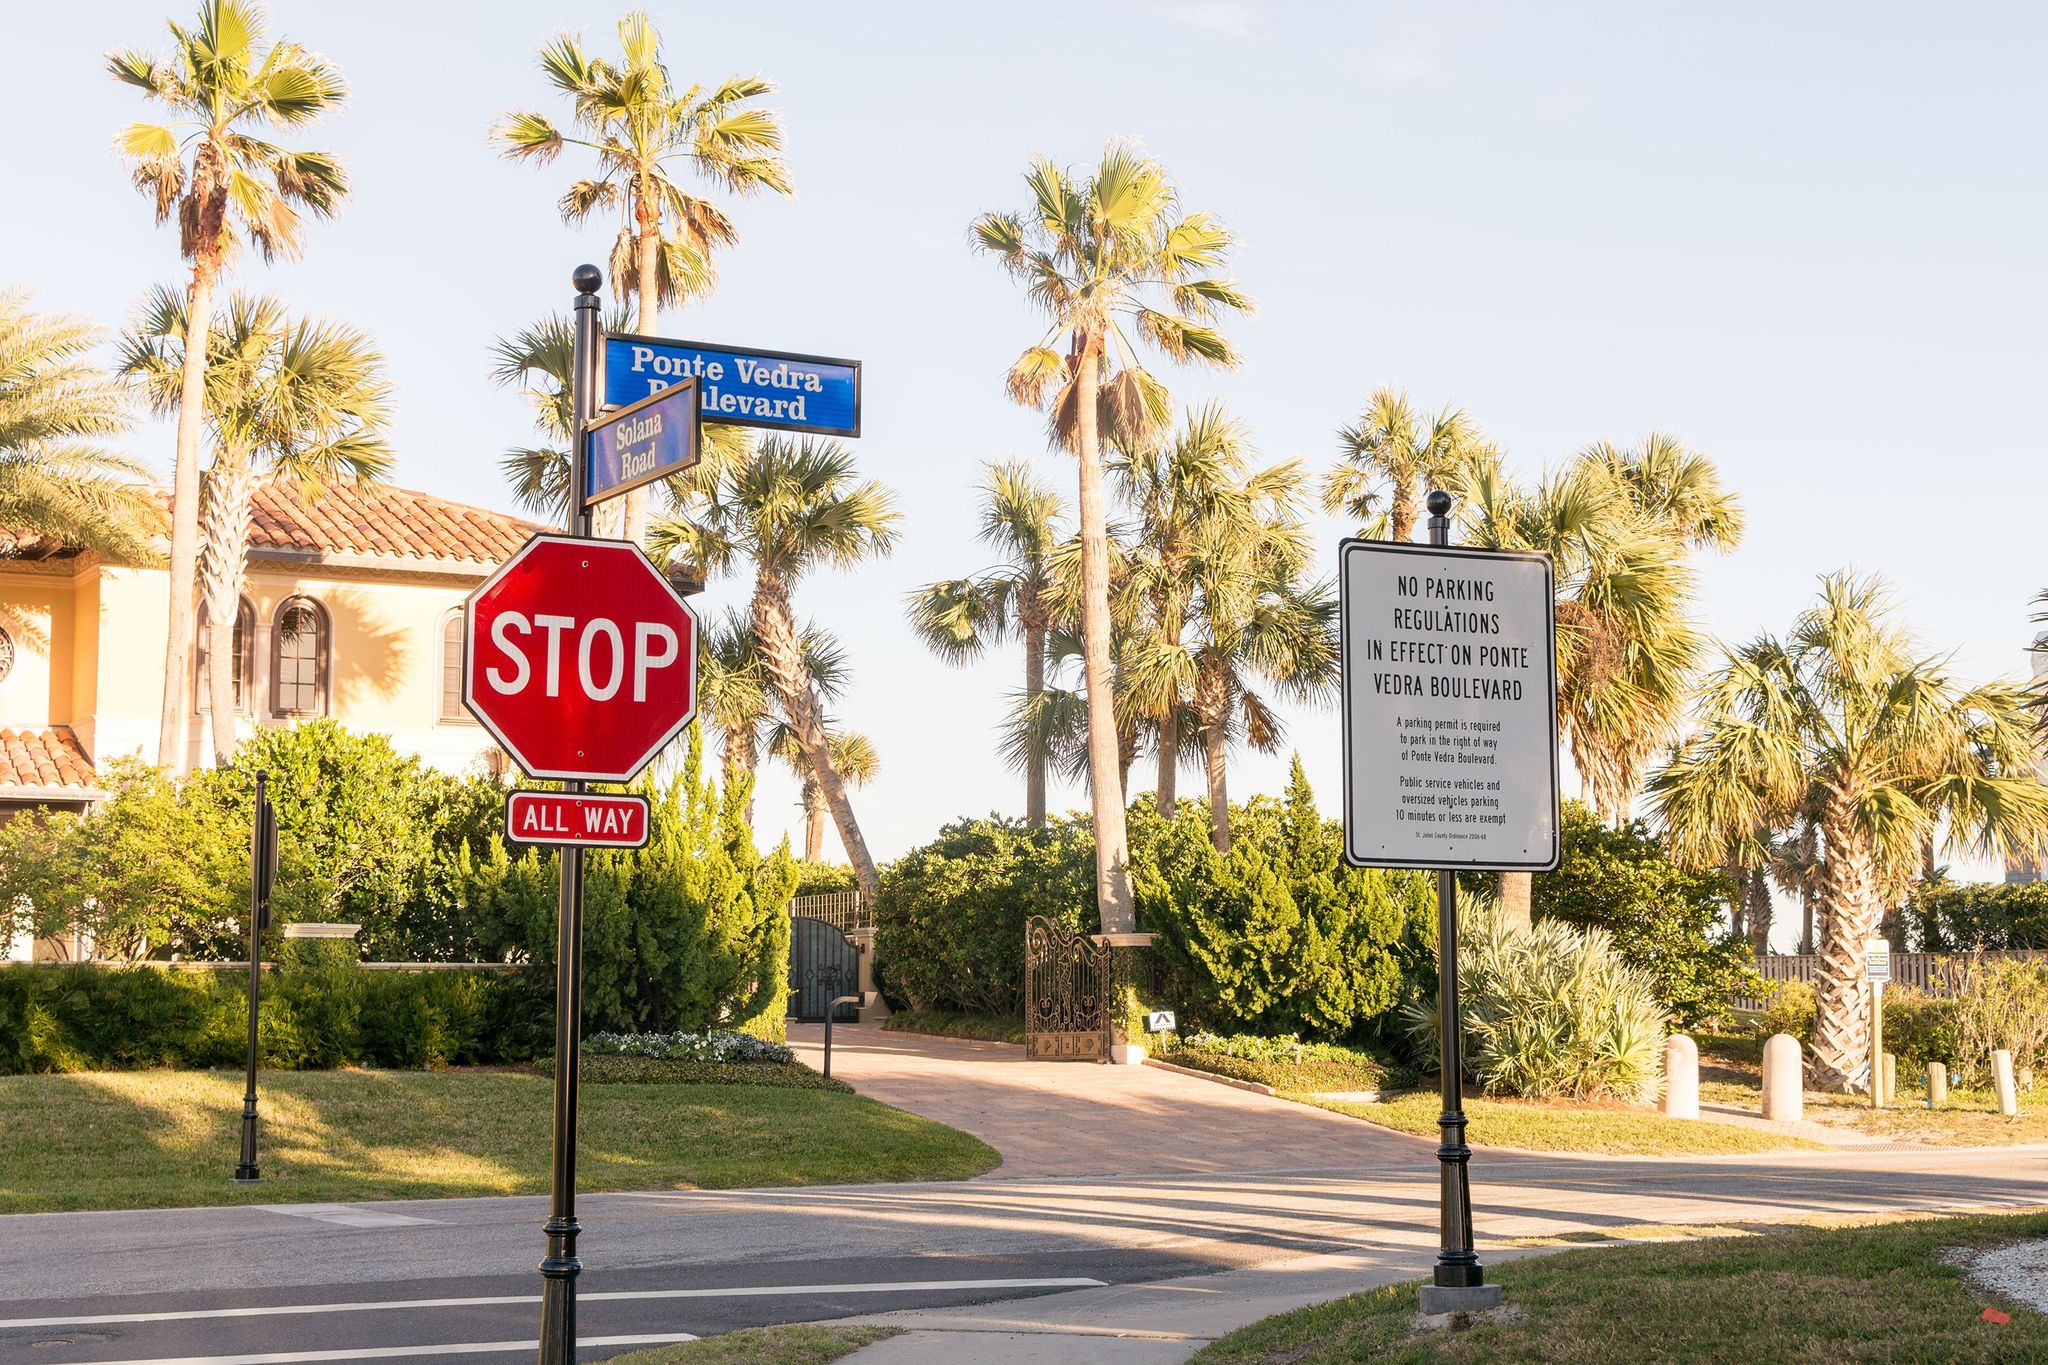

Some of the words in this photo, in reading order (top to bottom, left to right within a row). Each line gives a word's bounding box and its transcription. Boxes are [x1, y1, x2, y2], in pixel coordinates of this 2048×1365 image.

[631, 346, 724, 380] Ponte
[734, 358, 823, 393] Vedra
[647, 378, 807, 420] Blevard
[616, 413, 663, 450] Solana
[621, 442, 656, 480] Road
[1398, 575, 1418, 597] NO
[1426, 577, 1494, 602] PARKING
[1394, 608, 1500, 635] REGULATIONS
[486, 610, 679, 702] STOP
[1367, 639, 1382, 661] IN
[1391, 641, 1443, 664] EFFECT
[1451, 645, 1471, 666] ON
[1480, 646, 1529, 668] PONTE
[1373, 673, 1423, 697] VEDRA
[1431, 676, 1522, 701] BOULEVARD
[1396, 716, 1402, 727] A
[1404, 717, 1432, 731] parking
[1435, 718, 1459, 731] permit
[1461, 719, 1468, 730] is
[1470, 720, 1501, 733] required
[1400, 733, 1408, 744] to
[1410, 734, 1426, 746] park
[1429, 734, 1436, 745] in
[1439, 735, 1450, 746] the
[1453, 736, 1470, 749] right
[1473, 736, 1481, 747] of
[1483, 739, 1497, 750] way
[1401, 750, 1408, 761] of
[1411, 750, 1431, 762] Ponte
[1434, 751, 1455, 763] Vedra
[1458, 752, 1497, 765] Boulevard.
[1400, 776, 1422, 788] Public
[1425, 777, 1451, 789] service
[1454, 778, 1484, 790] vehicles
[1487, 779, 1500, 791] and
[1402, 793, 1435, 805] oversized
[1438, 795, 1468, 806] vehicles
[1471, 796, 1499, 810] parking
[523, 804, 569, 832] ALL
[584, 807, 633, 835] WAY
[1396, 809, 1405, 821] 10
[1407, 810, 1436, 822] minutes
[1438, 813, 1446, 822] or
[1449, 812, 1462, 823] less
[1465, 813, 1477, 823] are
[1479, 813, 1506, 826] exempt
